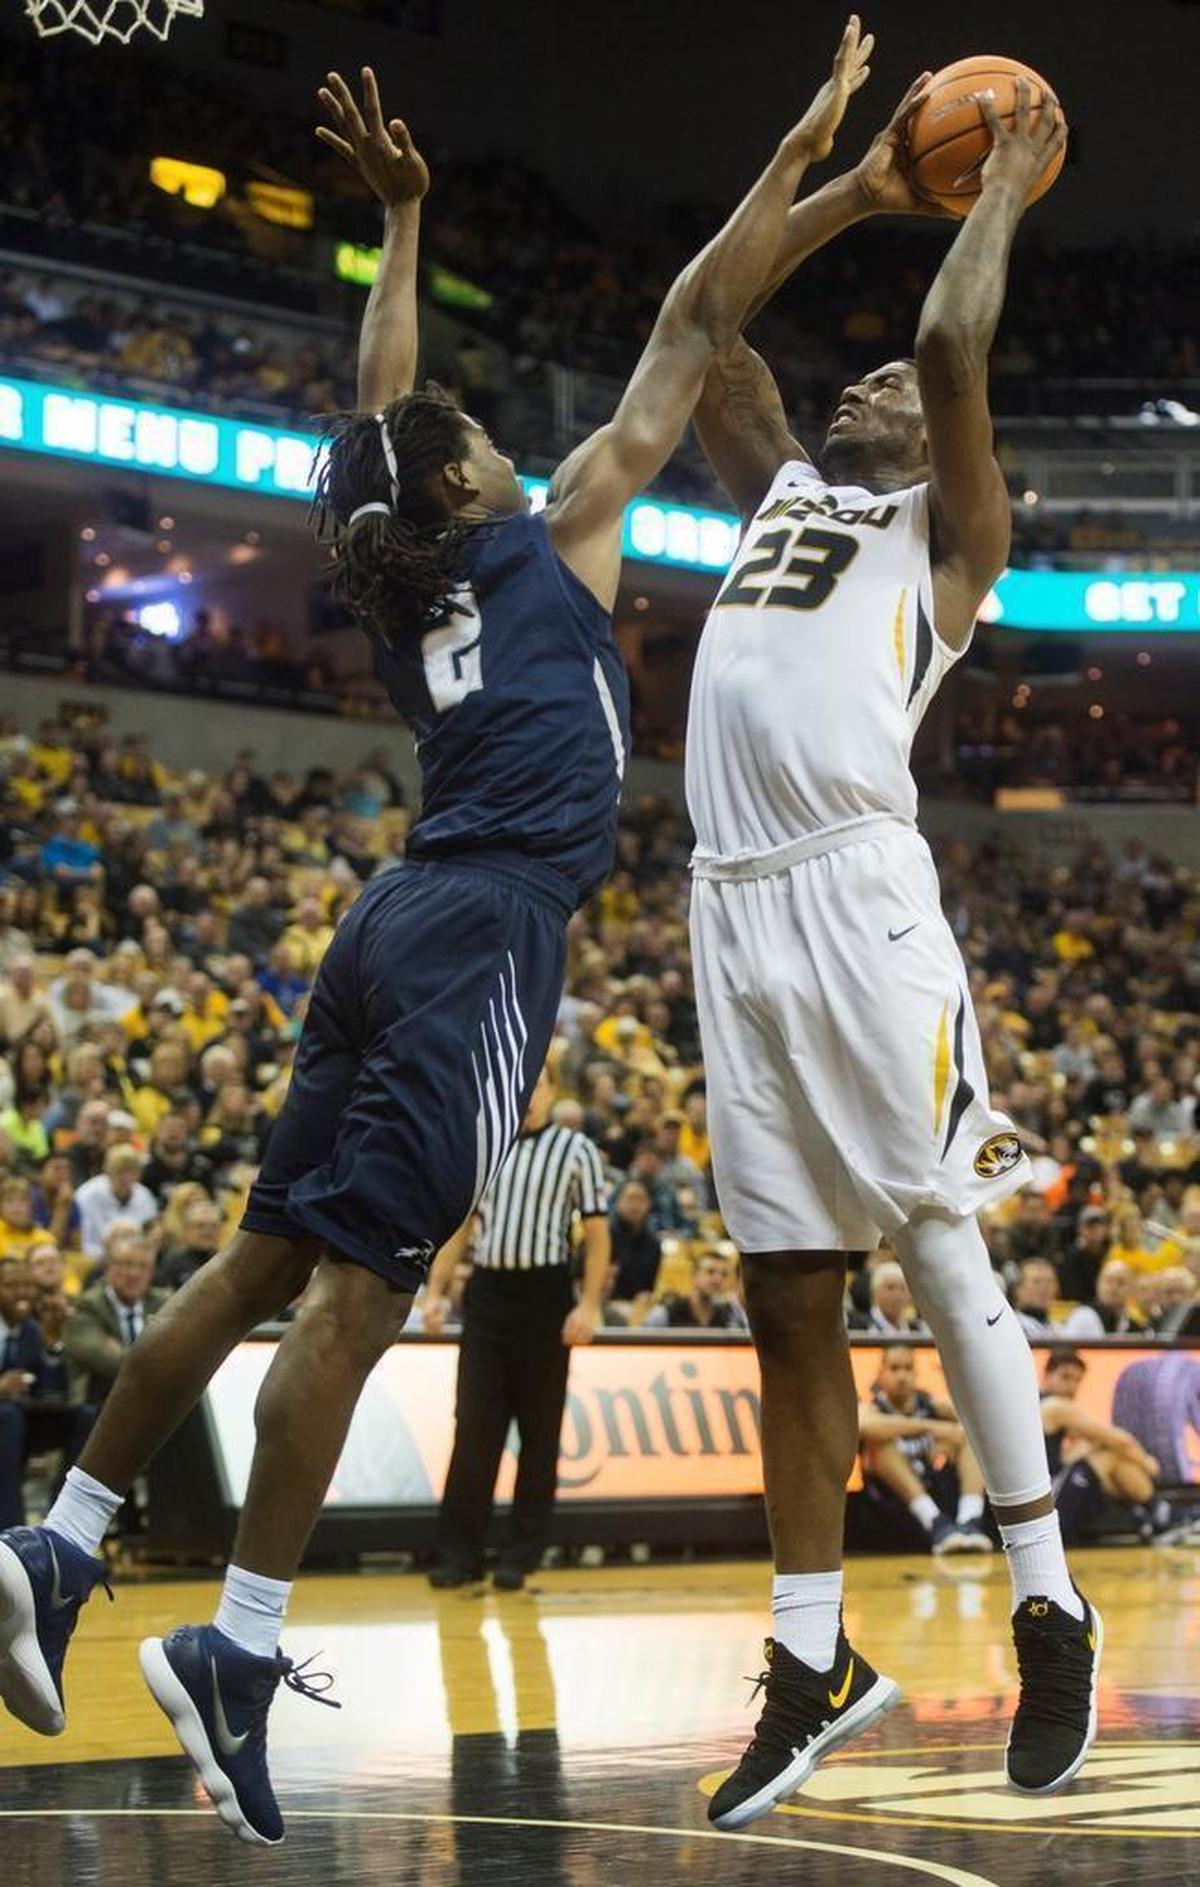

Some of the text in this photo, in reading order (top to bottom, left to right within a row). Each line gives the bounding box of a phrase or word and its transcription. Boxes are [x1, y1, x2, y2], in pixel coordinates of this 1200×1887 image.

[42, 393, 219, 475] MENU
[715, 527, 861, 612] 23
[1085, 581, 1186, 622] GET
[420, 580, 484, 713] 2
[556, 1361, 762, 1487] ontin
